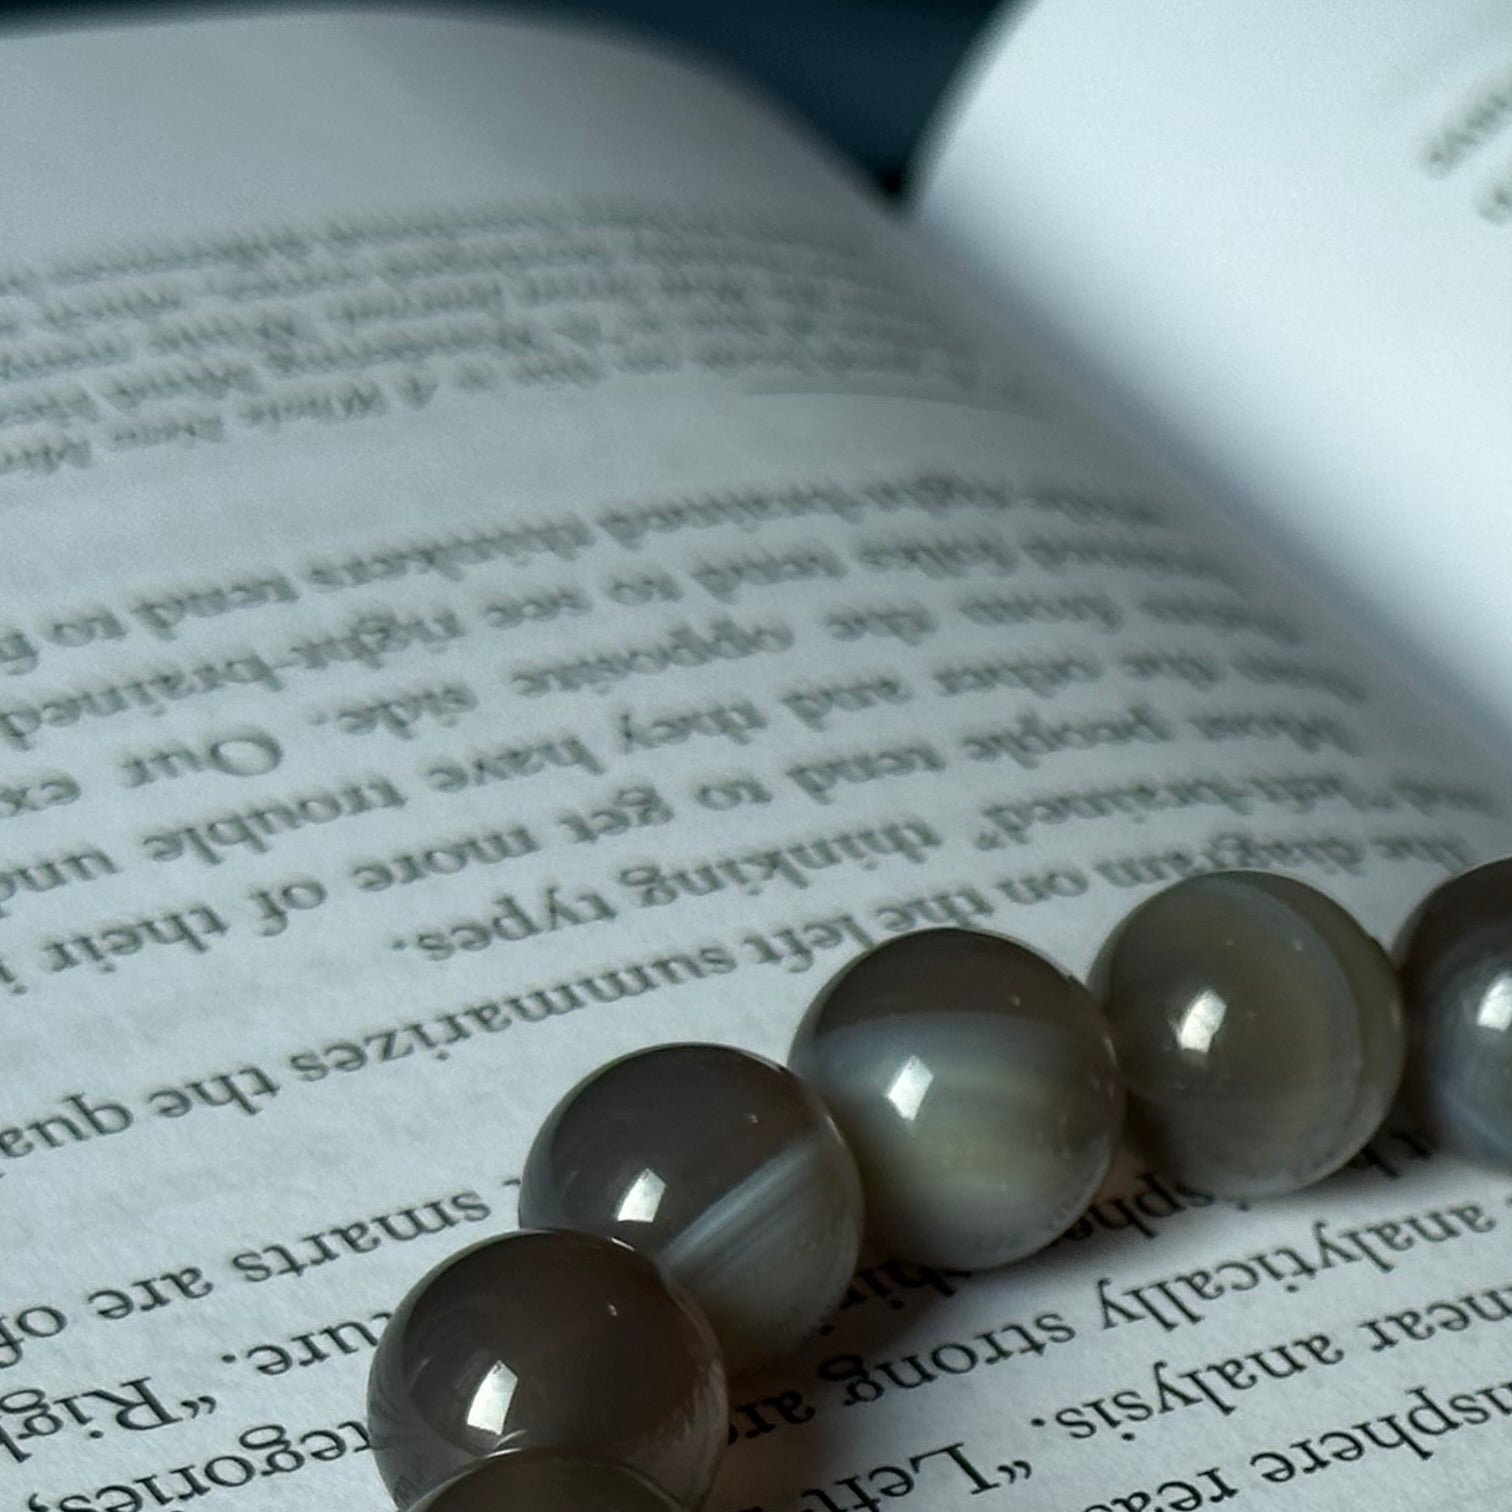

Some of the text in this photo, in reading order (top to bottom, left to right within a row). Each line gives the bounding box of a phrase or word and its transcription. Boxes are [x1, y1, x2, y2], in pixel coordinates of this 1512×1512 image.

[44, 609, 127, 649] to
[128, 573, 300, 643] tend
[508, 617, 796, 702] opposite
[307, 683, 479, 742] side.
[615, 696, 769, 759] they
[781, 674, 915, 733] and
[118, 733, 284, 791] Our
[426, 733, 607, 794] have
[960, 703, 1174, 770] people
[691, 773, 773, 816] to
[784, 741, 946, 806] tend
[141, 775, 408, 867] trouble
[557, 786, 675, 847] get
[348, 822, 541, 894] more
[614, 821, 943, 912] thinking
[993, 866, 1091, 910] on
[38, 903, 230, 976] their
[253, 877, 330, 938] of
[390, 885, 619, 966] types.
[873, 885, 994, 942] the
[740, 912, 859, 974] left
[286, 943, 732, 1091] summarizes
[147, 1062, 282, 1121] the
[229, 1190, 492, 1286] smarts
[1092, 1202, 1498, 1332] analytically
[86, 1267, 214, 1321] are
[816, 1311, 1077, 1410] strong
[1029, 1330, 1345, 1442] analysis.
